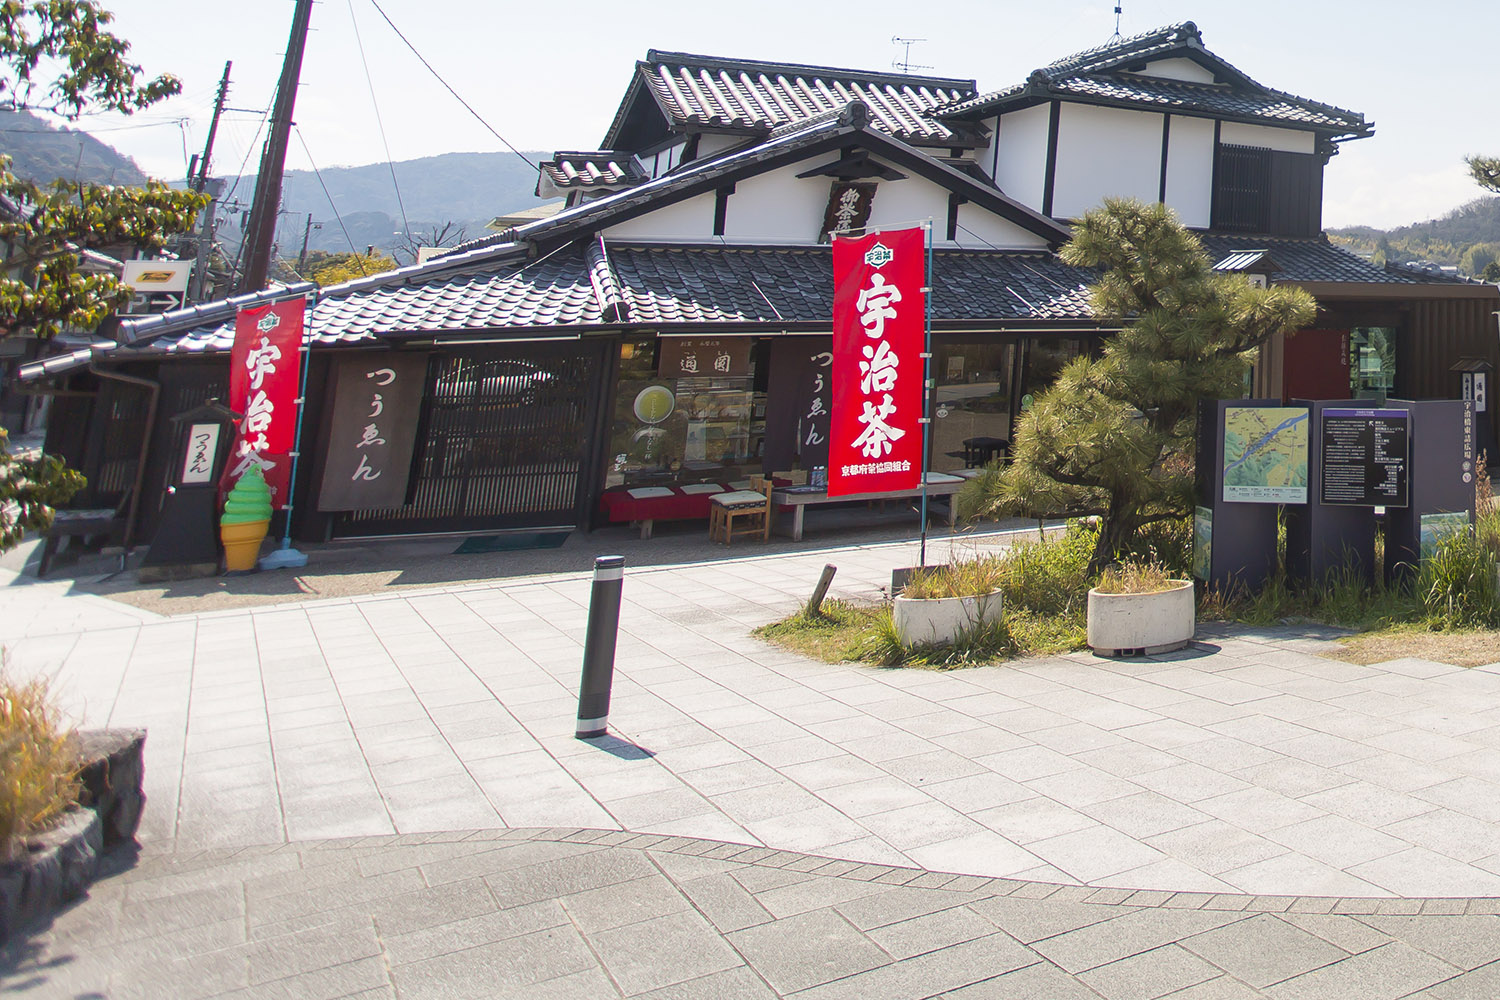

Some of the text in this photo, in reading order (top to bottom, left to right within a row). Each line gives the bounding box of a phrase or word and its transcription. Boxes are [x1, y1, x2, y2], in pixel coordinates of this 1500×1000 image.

[805, 352, 833, 446] つうゑん
[851, 273, 906, 458] 宇治茶
[188, 433, 211, 474] つうゑん
[351, 368, 397, 481] つうゑん
[841, 460, 911, 476] 京都府茶協同組合
